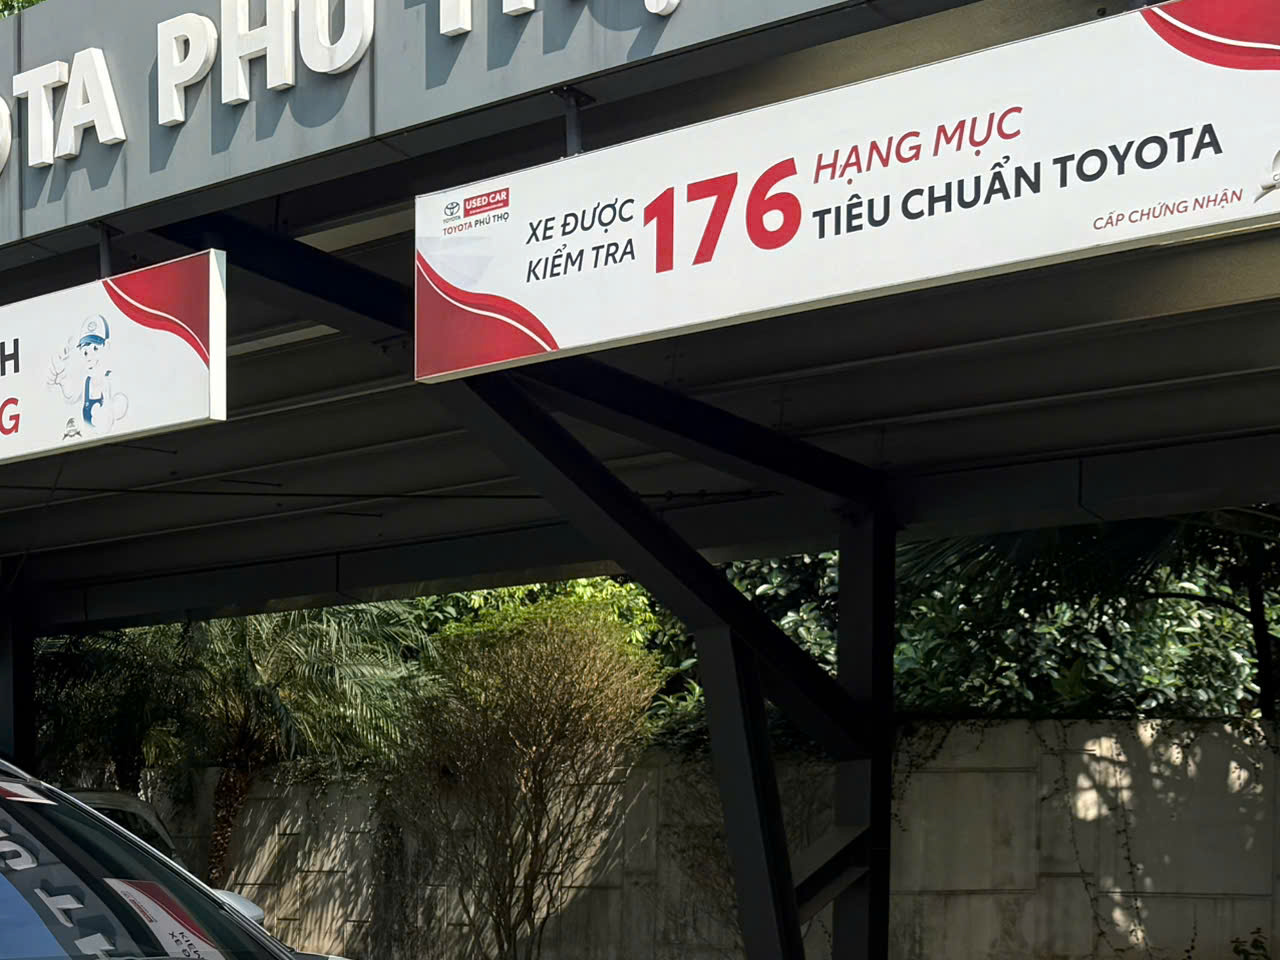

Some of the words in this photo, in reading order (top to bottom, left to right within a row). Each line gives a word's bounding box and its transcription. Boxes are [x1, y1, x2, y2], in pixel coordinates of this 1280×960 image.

[813, 131, 921, 184] HẠNG
[933, 106, 1023, 157] MỤC
[466, 197, 488, 209] USED
[489, 191, 506, 203] CAR
[812, 194, 891, 240] TIÊU
[900, 155, 1041, 220] CHUẨN
[1052, 123, 1223, 188] TOYOTA
[443, 222, 472, 236] TOYOTA
[474, 215, 490, 228] PHÚ
[492, 212, 509, 222] THỌ
[525, 216, 555, 245] XE
[561, 197, 635, 237] ĐƯỢC
[643, 157, 802, 274] 176
[1093, 209, 1125, 230] CẤP
[1128, 201, 1188, 223] CHỨNG
[1192, 188, 1243, 210] NHẬN
[525, 243, 585, 283] KIỂM
[591, 238, 636, 269] TRA
